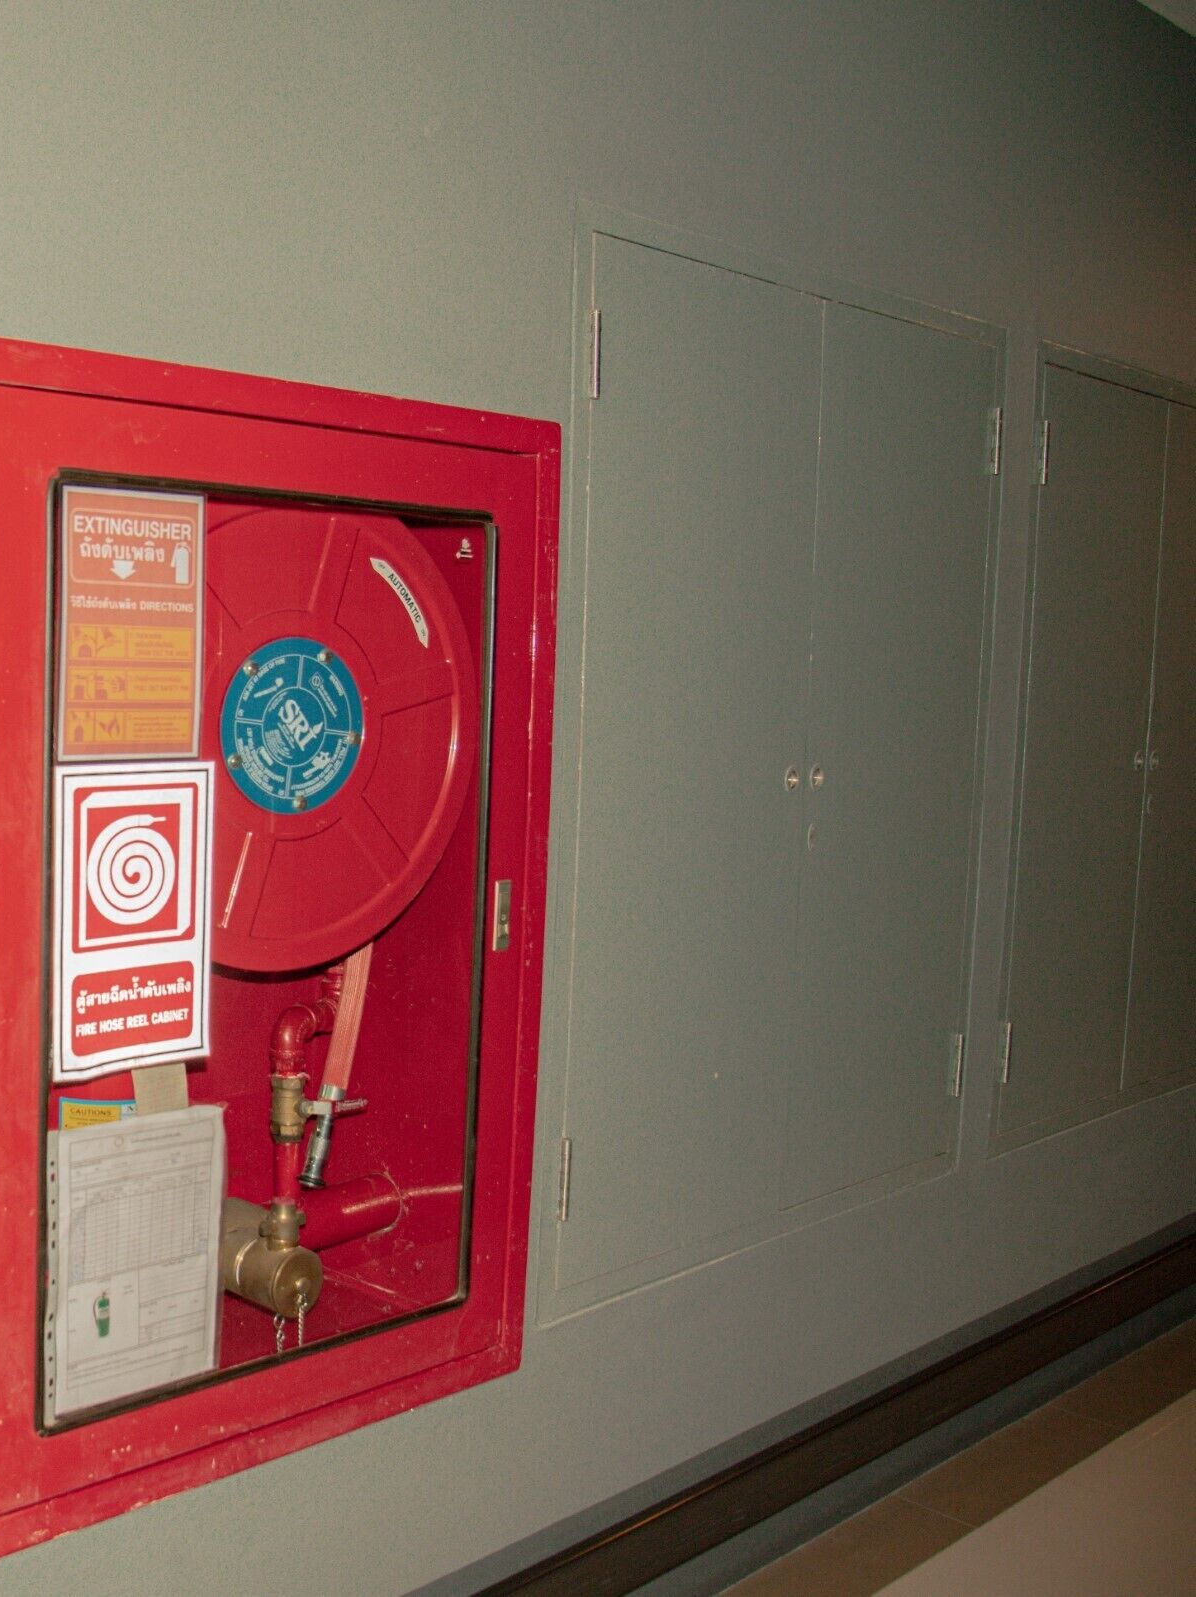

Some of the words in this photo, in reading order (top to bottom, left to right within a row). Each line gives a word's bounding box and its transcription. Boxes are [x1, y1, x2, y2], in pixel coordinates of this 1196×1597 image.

[73, 514, 192, 541] EXTINGUISHER
[79, 536, 165, 563] ถังดับเพลิง
[139, 600, 194, 613] DIRECTIONS
[387, 573, 422, 623] AUTOMATIC
[75, 1022, 97, 1037] FIRE
[99, 1017, 125, 1033] HOSE
[126, 1014, 149, 1029] REEL
[151, 1008, 189, 1025] CABINET
[69, 1106, 112, 1115] CAUTIONS
